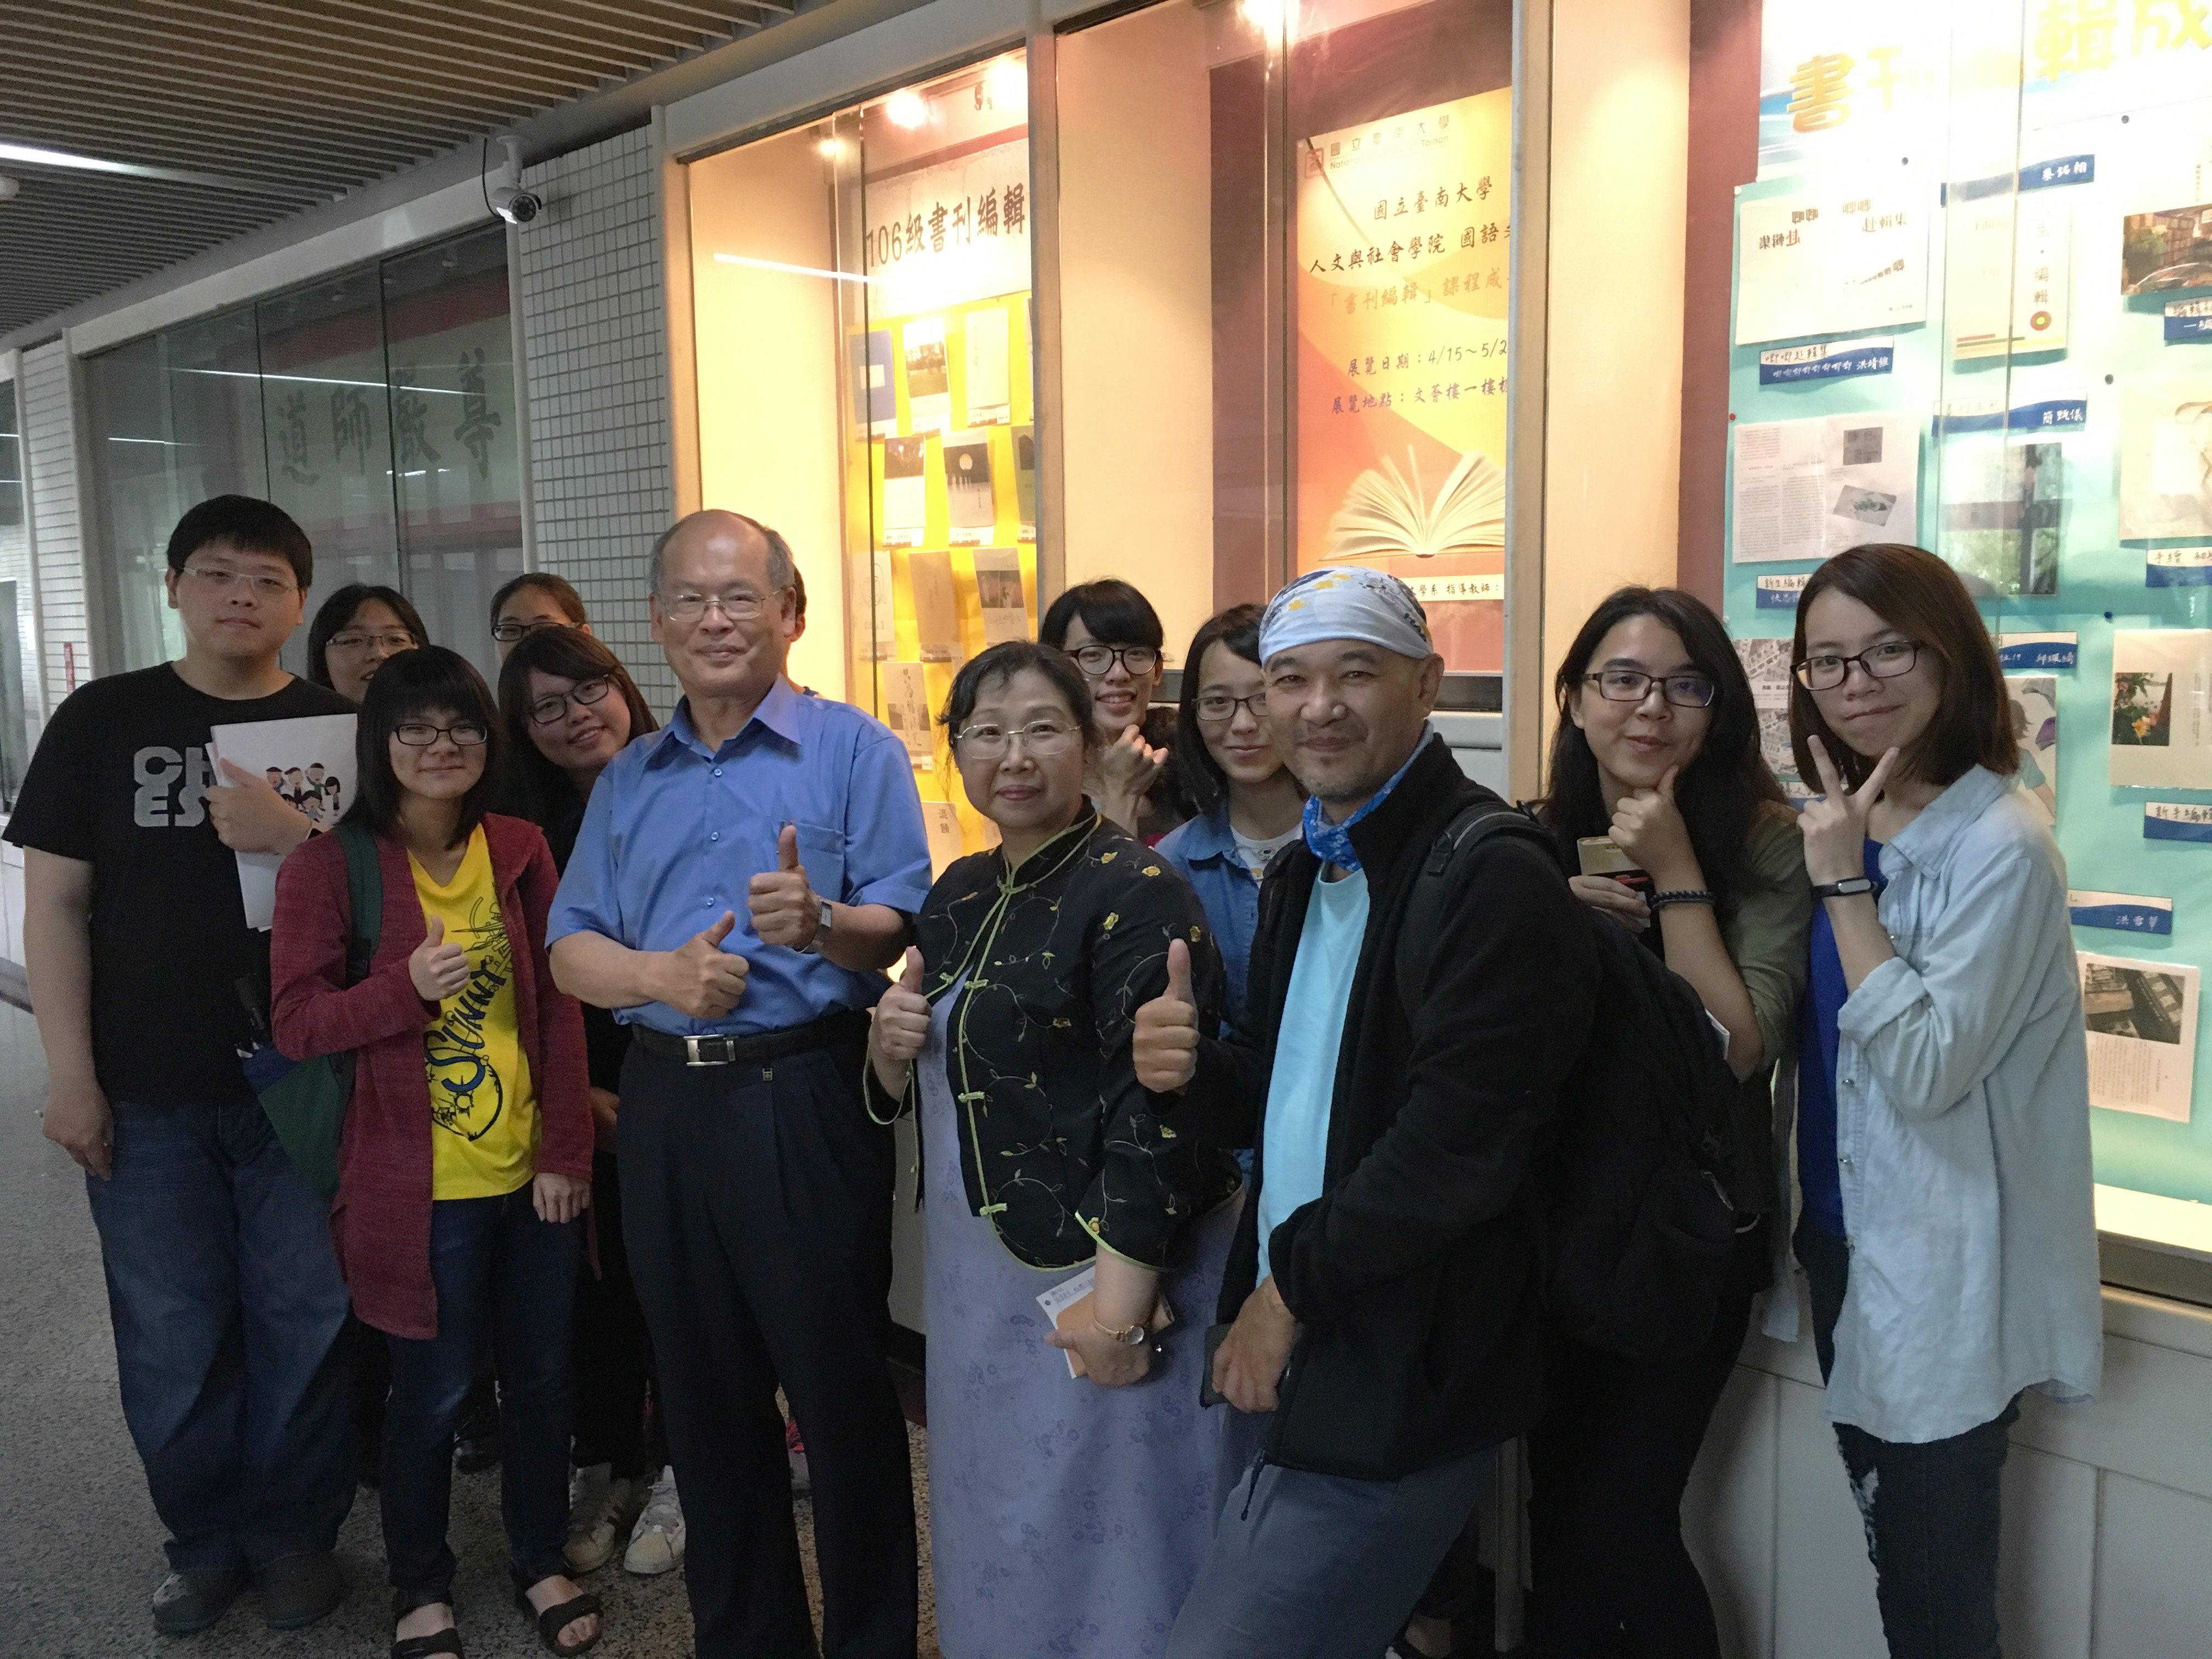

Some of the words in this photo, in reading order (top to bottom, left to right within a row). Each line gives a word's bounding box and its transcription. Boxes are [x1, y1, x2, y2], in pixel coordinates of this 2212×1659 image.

[1420, 136, 1449, 148] Tainan
[1374, 176, 1493, 221] 國立臺南大學
[866, 182, 1025, 268] 106級書刊編輯
[1310, 233, 1446, 273] 人文與社會學院
[1443, 267, 1510, 297] 課程成
